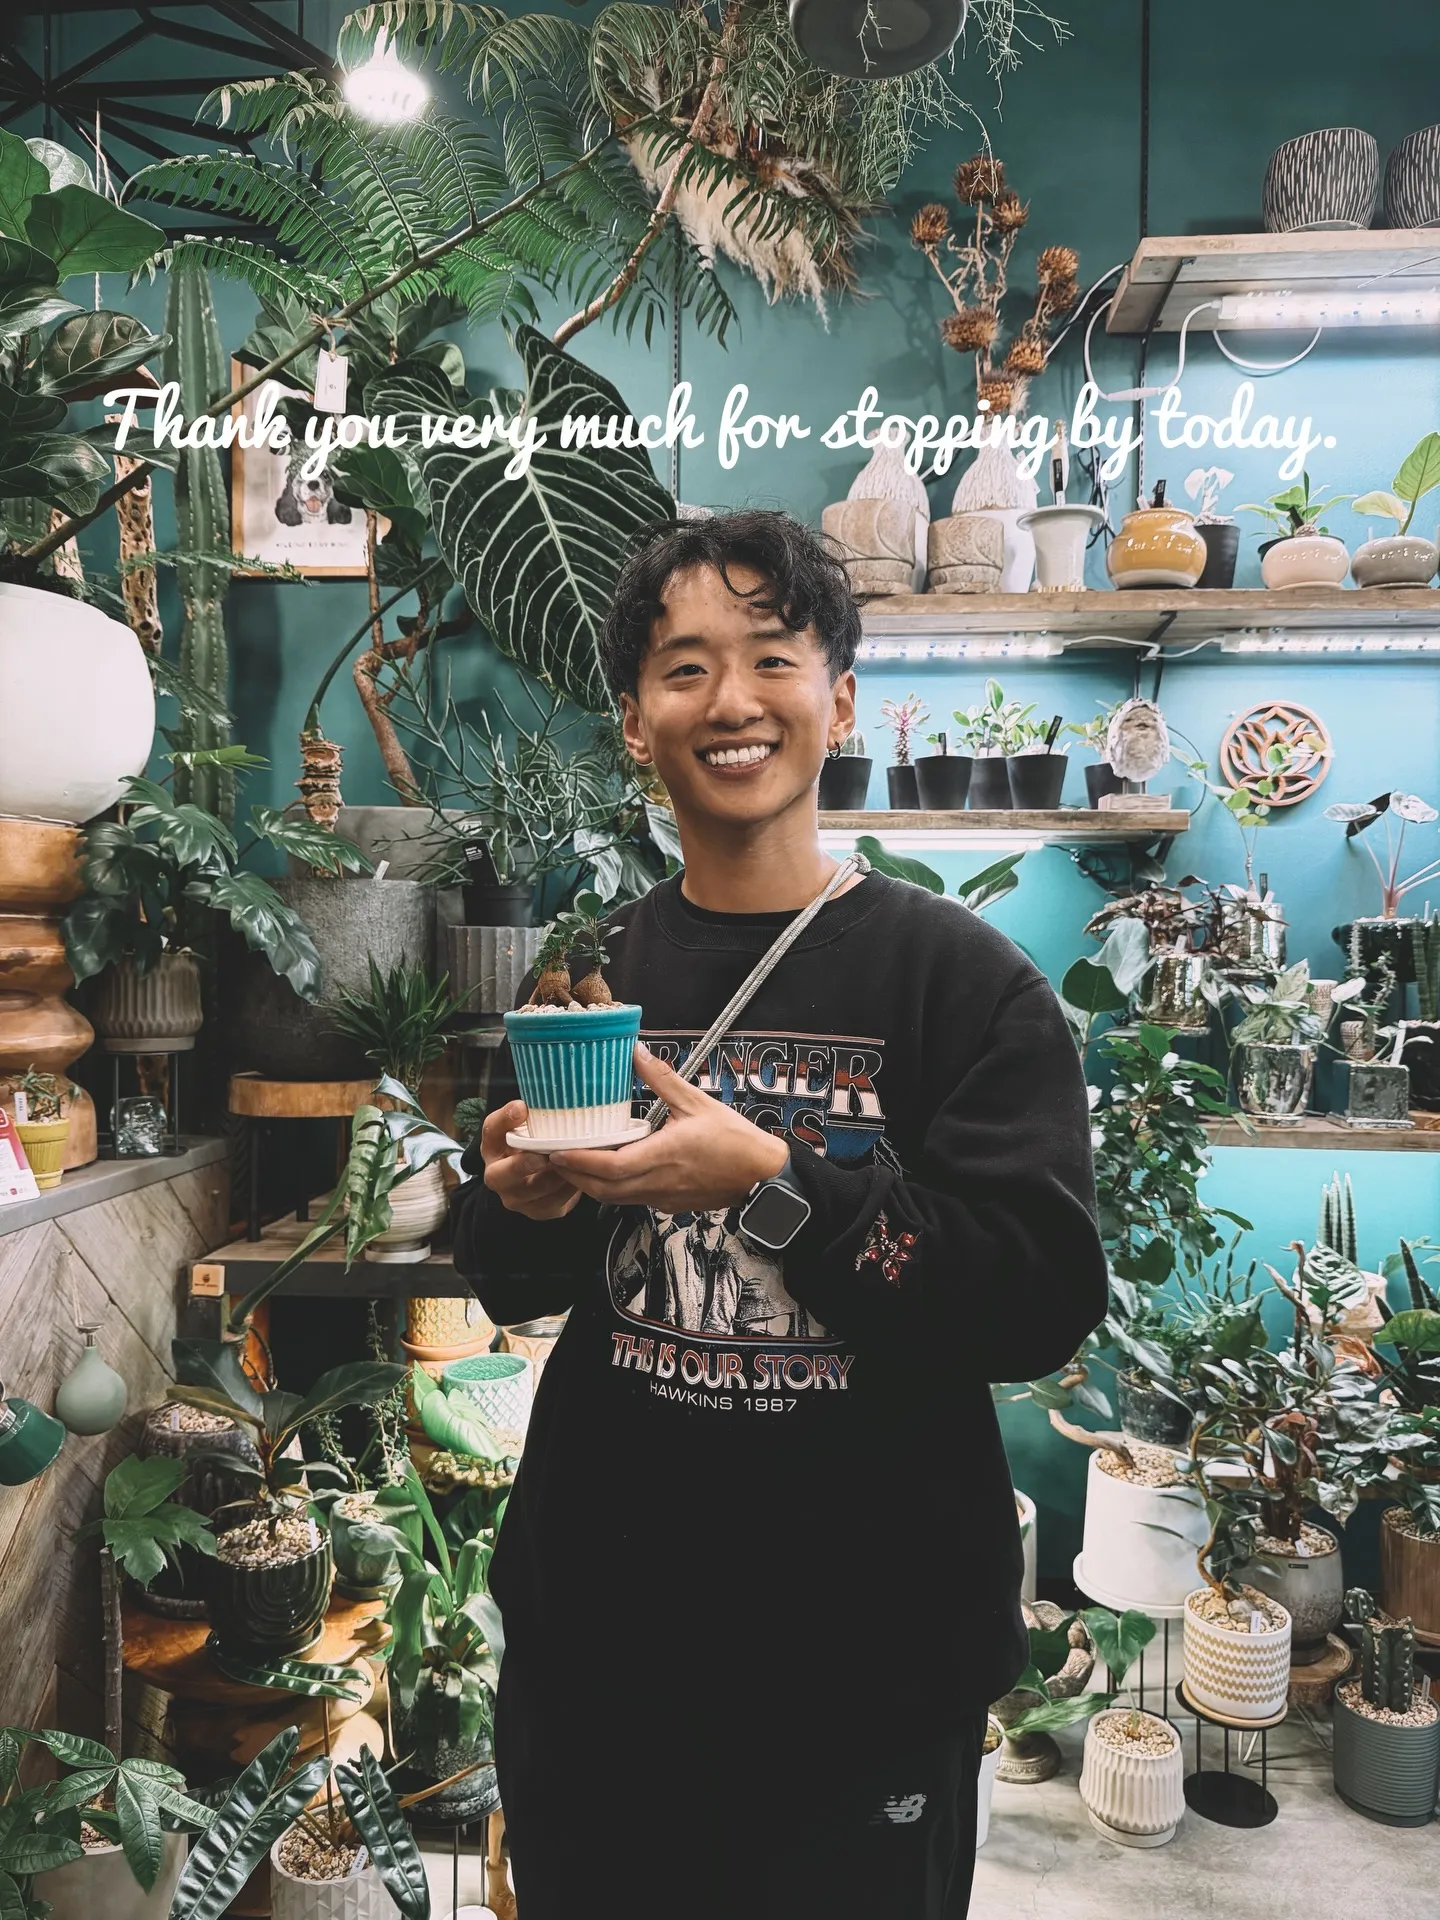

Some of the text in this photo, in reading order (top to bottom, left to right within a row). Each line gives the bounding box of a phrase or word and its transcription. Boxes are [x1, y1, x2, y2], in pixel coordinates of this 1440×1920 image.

[612, 1332, 856, 1391] THIS IS OUR STORY
[650, 1380, 798, 1412] HAWKINS 1987
